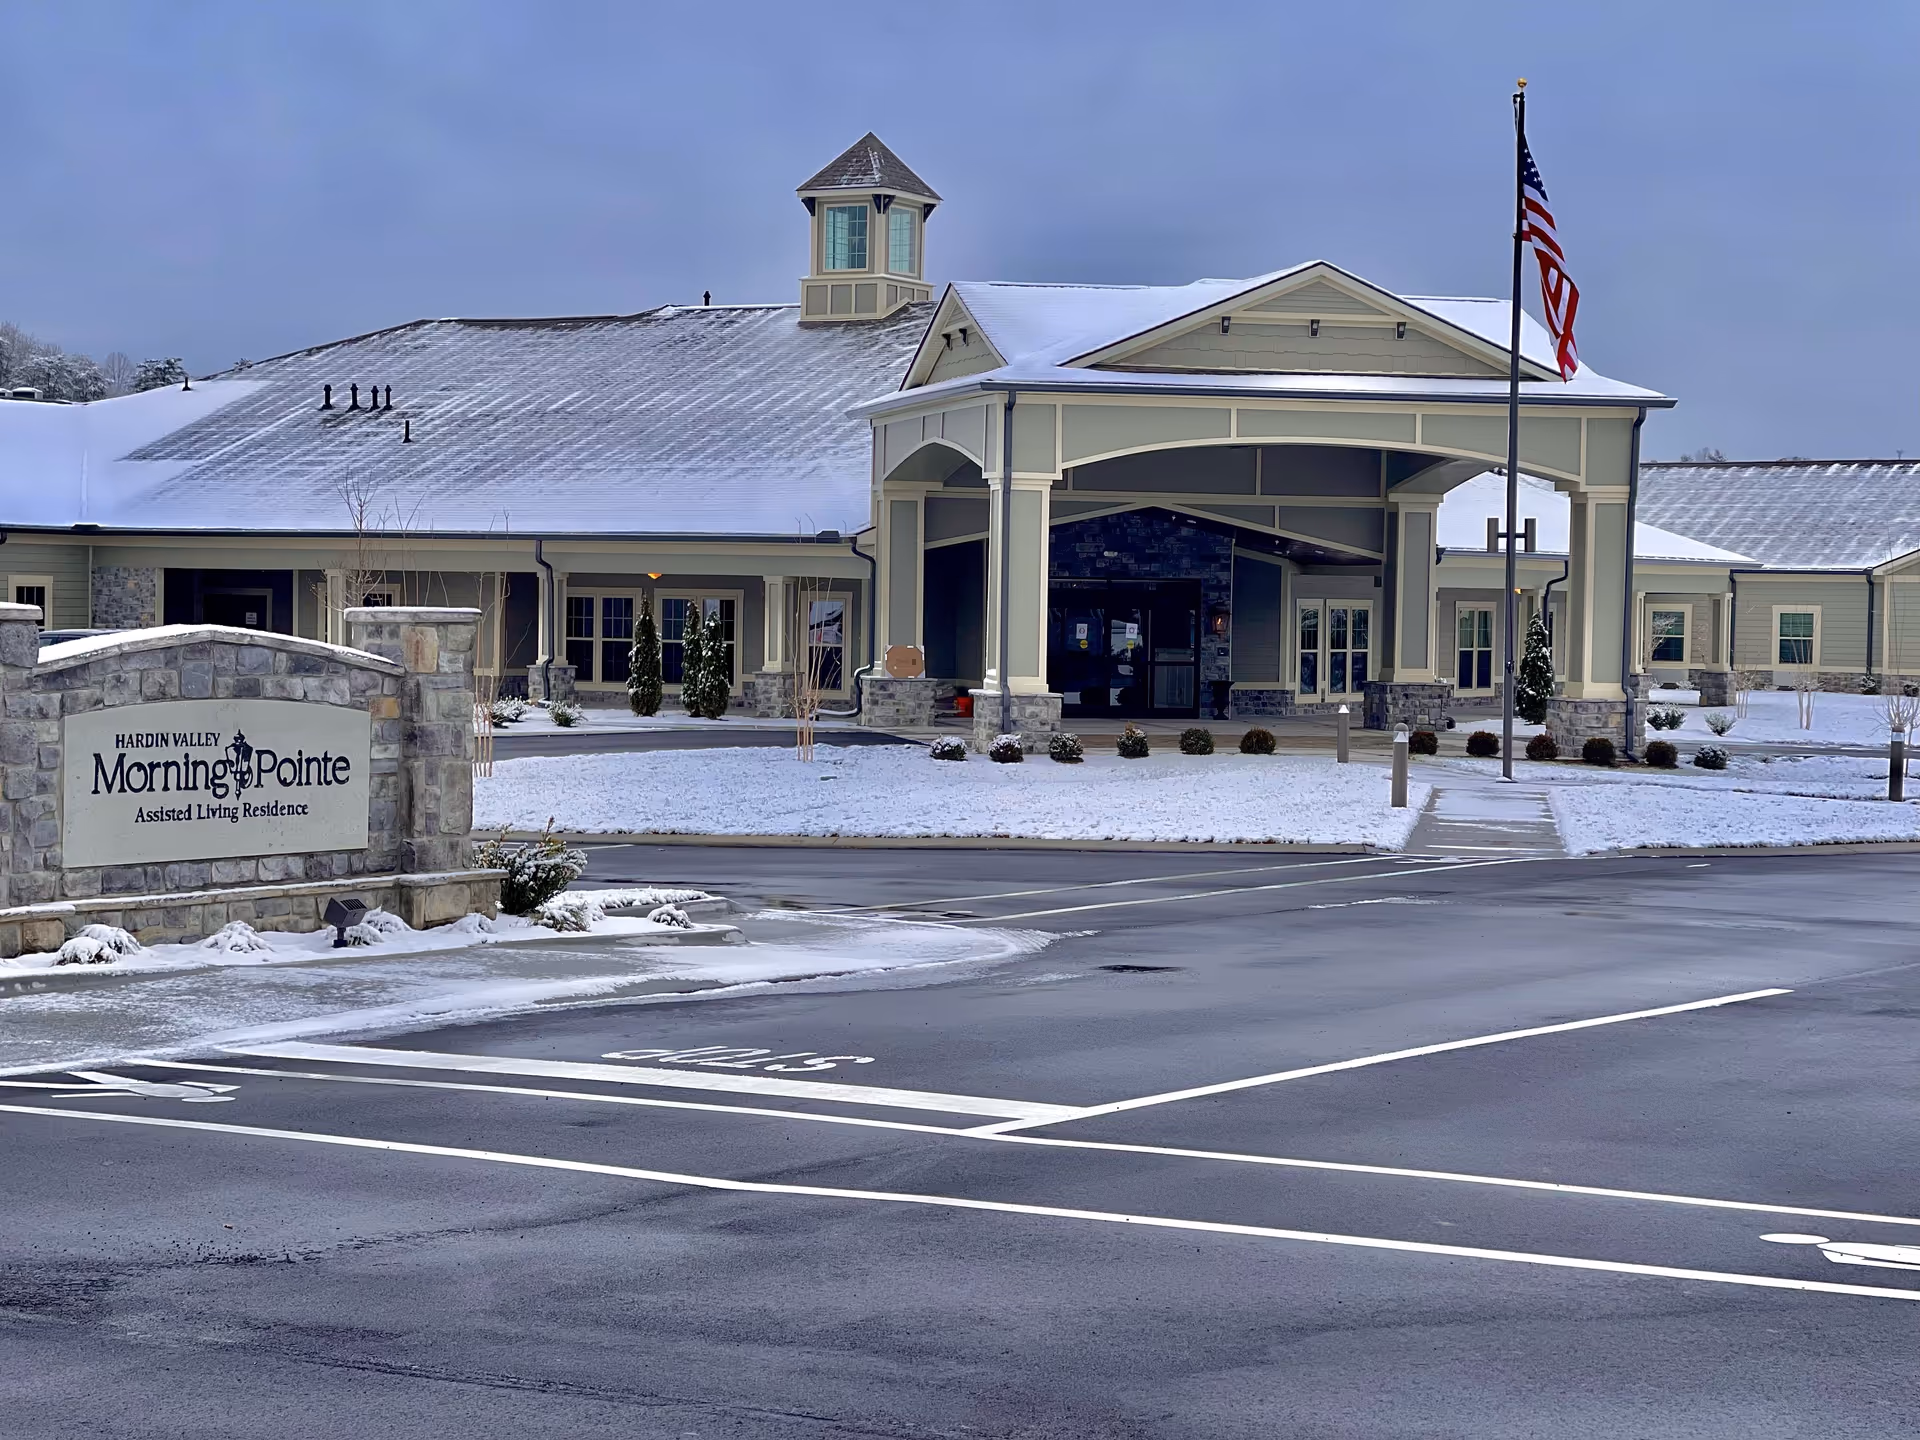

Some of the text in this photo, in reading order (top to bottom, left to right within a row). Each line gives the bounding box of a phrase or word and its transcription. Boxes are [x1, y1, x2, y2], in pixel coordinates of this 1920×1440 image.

[115, 732, 221, 749] HARDIN VALLEY
[91, 749, 351, 800] Morning Pointe
[134, 799, 310, 824] Assisted Living Residence
[600, 1045, 876, 1072] STOP
